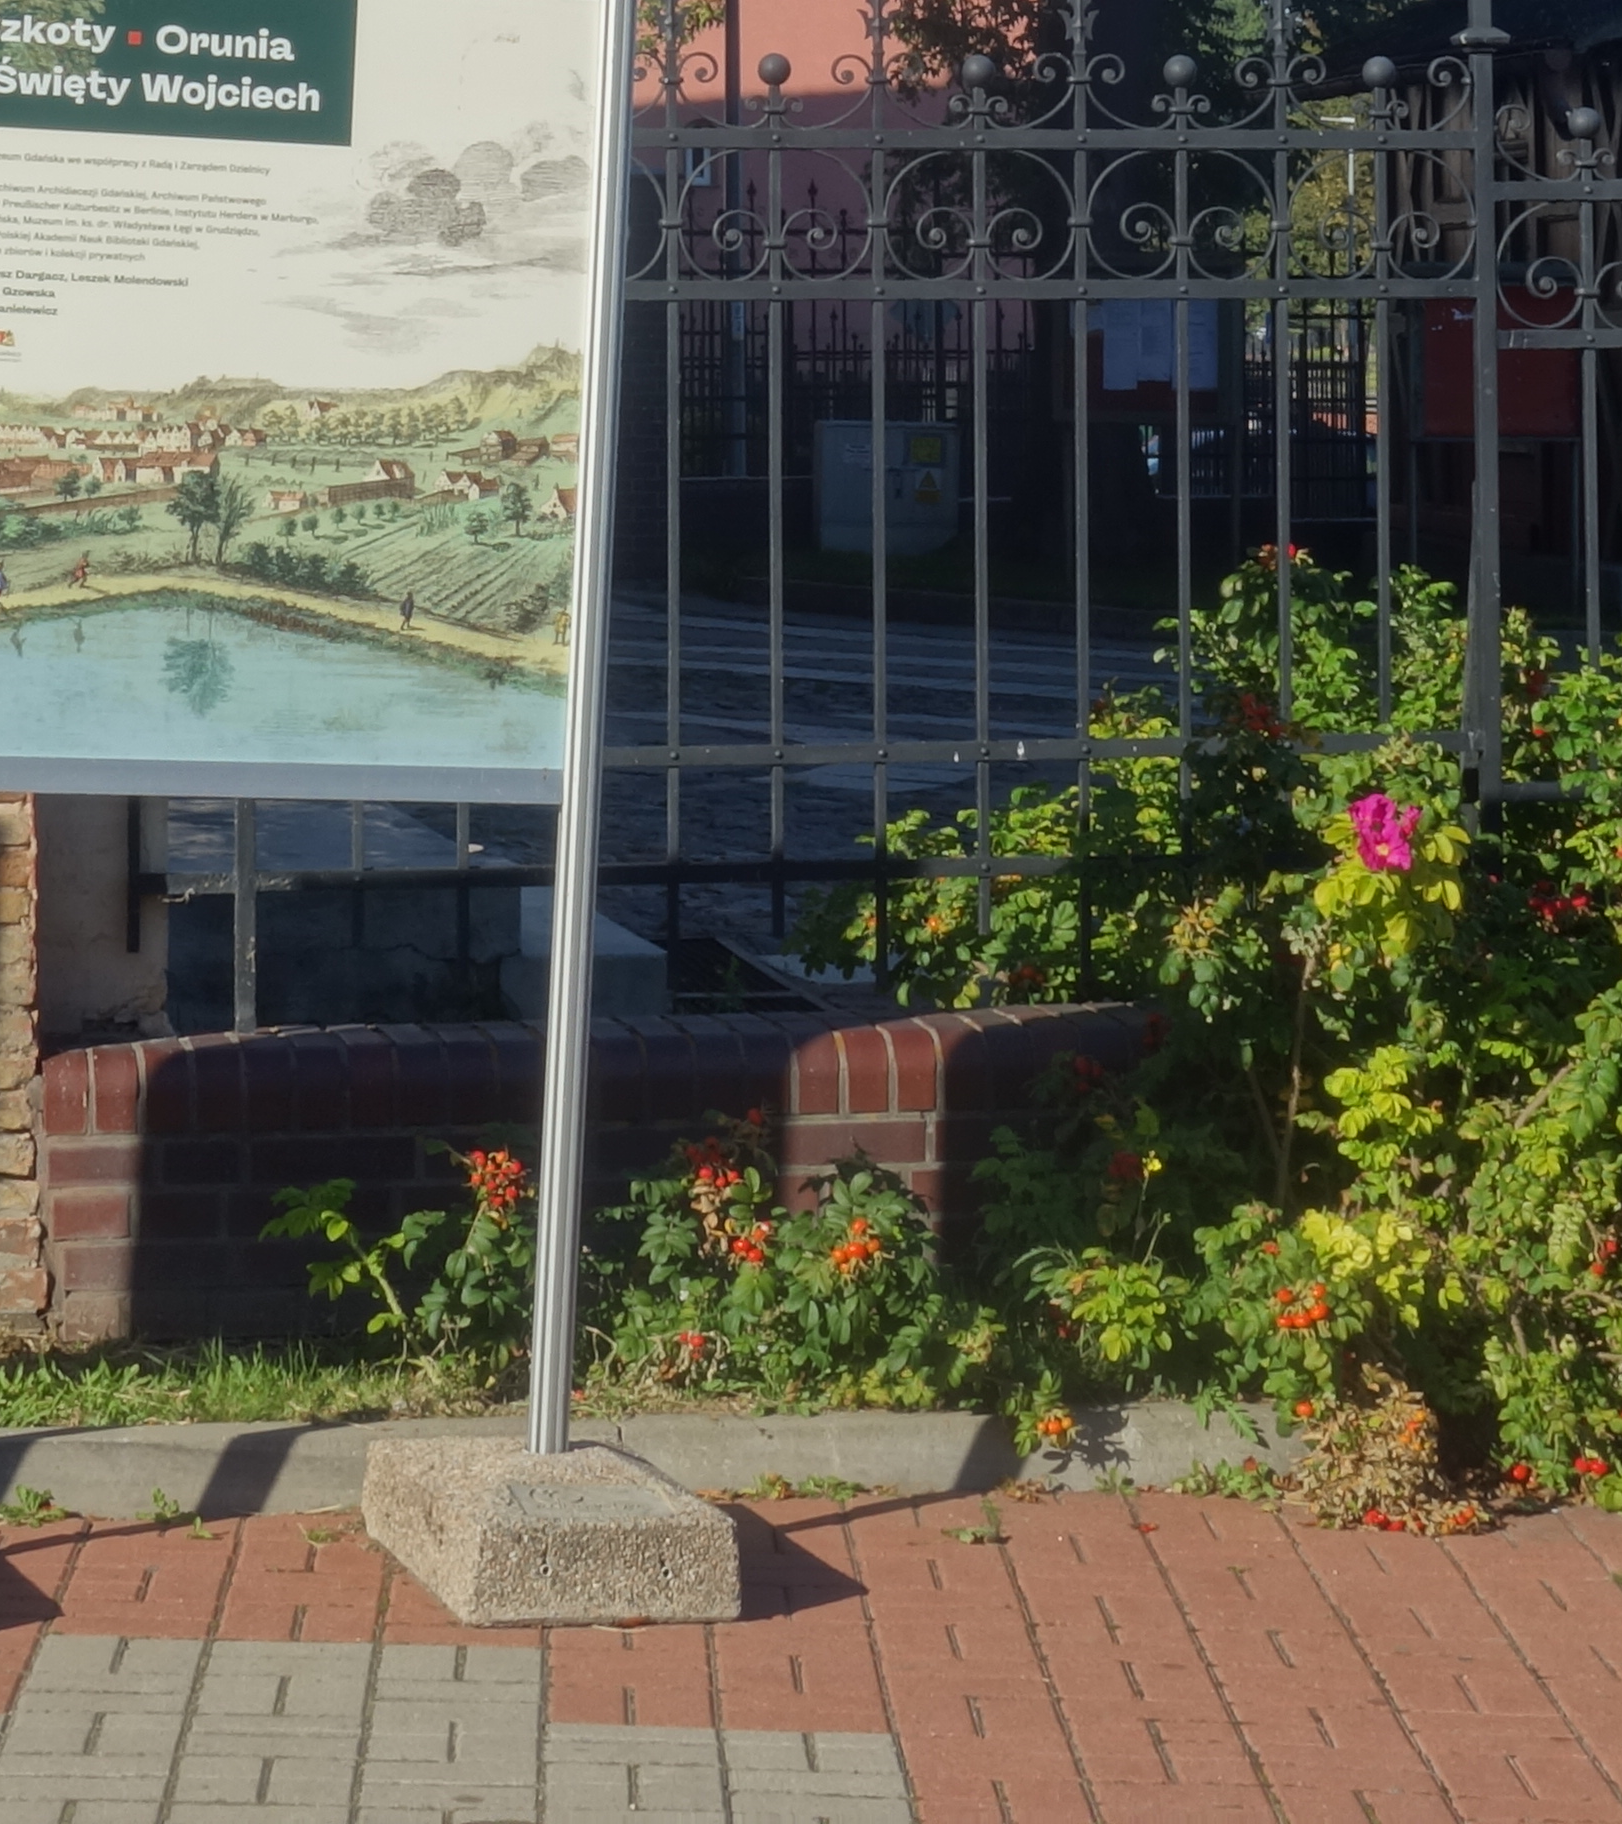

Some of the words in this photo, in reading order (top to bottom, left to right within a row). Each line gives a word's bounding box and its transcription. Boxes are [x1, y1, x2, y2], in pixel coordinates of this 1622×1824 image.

[155, 24, 294, 61] Orunia
[142, 73, 320, 112] Wojciech
[23, 153, 65, 164] Gdańska
[67, 157, 82, 165] we
[84, 157, 139, 169] współpracy
[141, 160, 147, 168] z
[148, 159, 173, 171] Radą
[174, 161, 178, 169] i
[229, 163, 271, 176] Dzielnicy
[100, 188, 149, 201] Gdańskiej,
[151, 191, 199, 202] Archiwum
[201, 193, 267, 207] Państwowego
[63, 202, 121, 213] Kulturbesitz
[134, 205, 173, 217] Berlinie,
[23, 215, 63, 226] Muzeum
[113, 220, 171, 232] Władysława
[205, 225, 260, 237] Grudziądzu,
[79, 234, 103, 244] Nauk
[152, 238, 200, 250] Gdańskiej,
[3, 247, 43, 256] zbiorów
[45, 248, 49, 257] i
[88, 252, 146, 262] prywatnych
[15, 269, 68, 283] Dargacz,
[71, 273, 111, 283] Leszek
[113, 275, 189, 287] Molendowski
